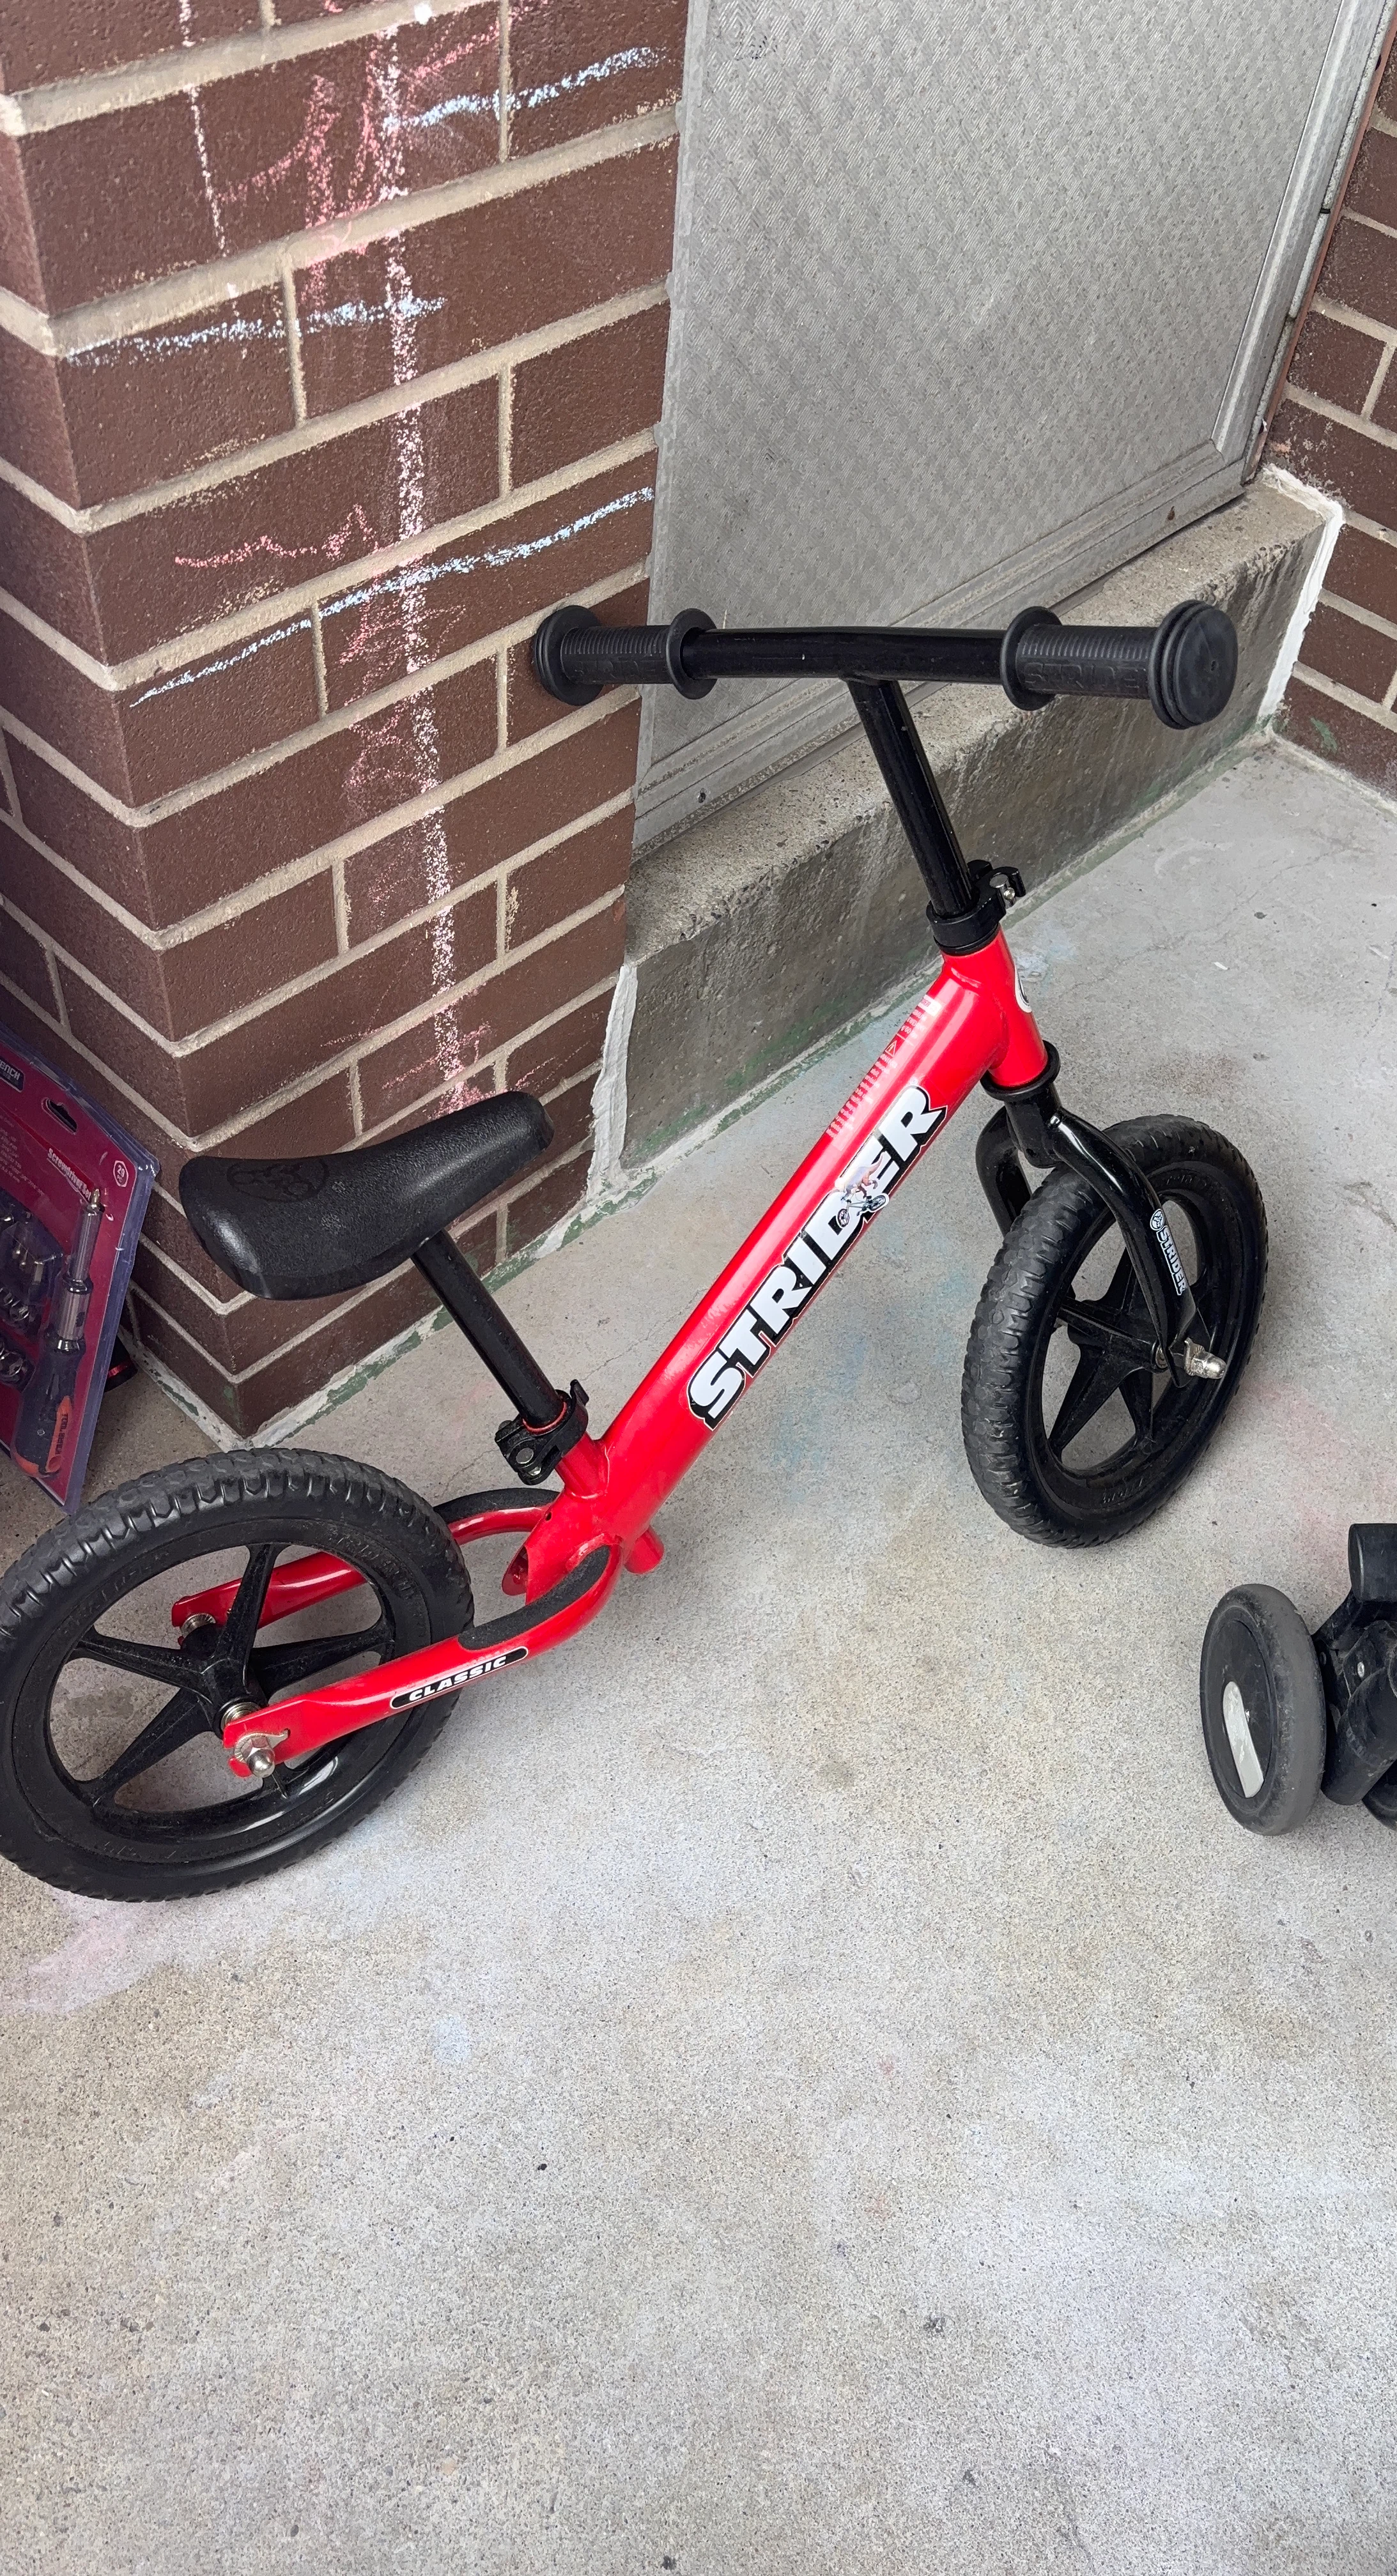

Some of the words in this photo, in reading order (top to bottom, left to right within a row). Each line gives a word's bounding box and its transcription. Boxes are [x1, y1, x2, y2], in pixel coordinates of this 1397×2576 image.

[687, 1086, 946, 1429] STRIDER
[1157, 1226, 1186, 1294] STRIDER
[409, 1656, 507, 1702] CLASSIC
